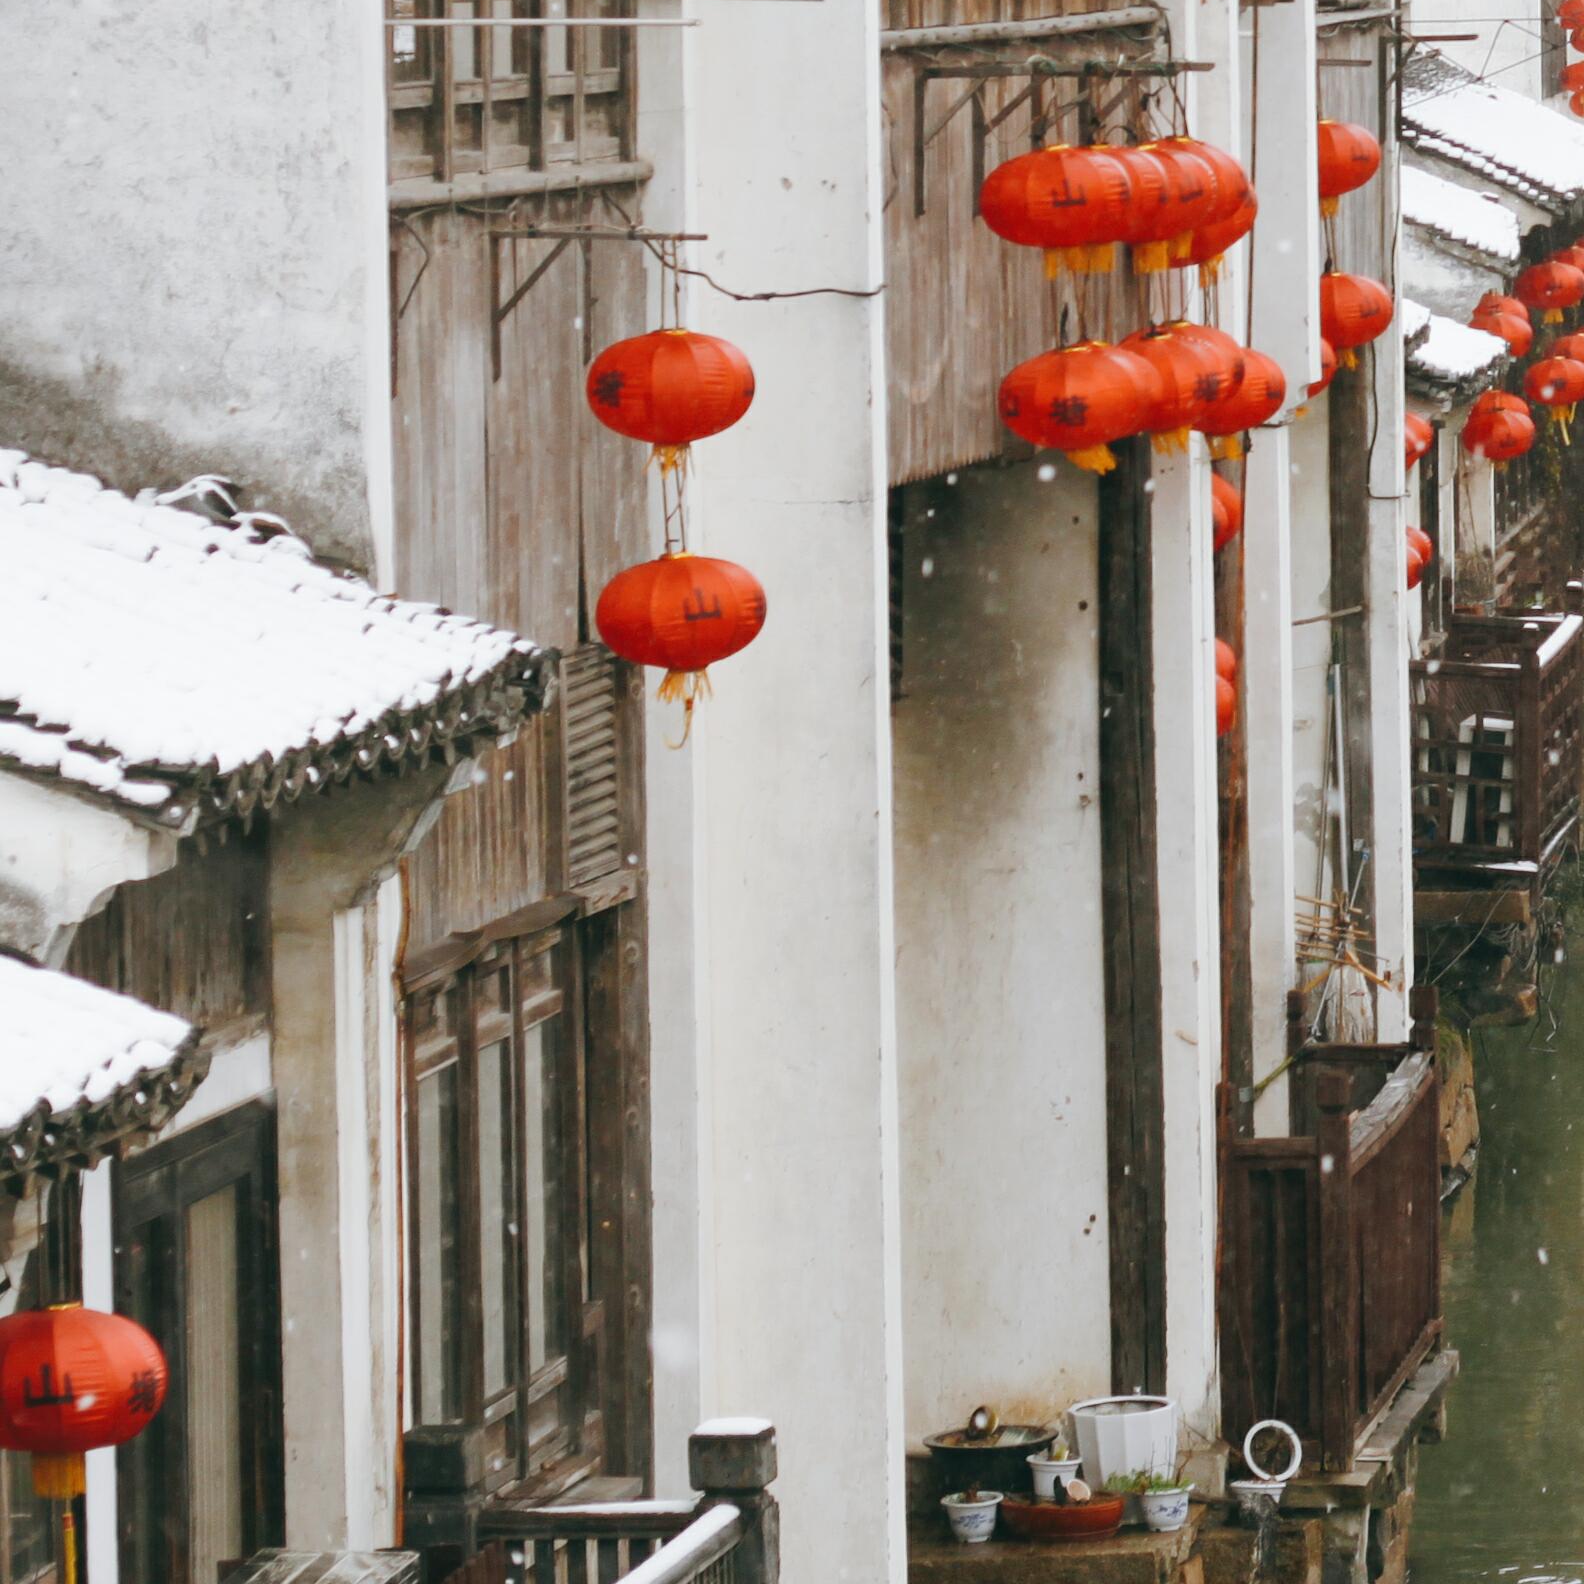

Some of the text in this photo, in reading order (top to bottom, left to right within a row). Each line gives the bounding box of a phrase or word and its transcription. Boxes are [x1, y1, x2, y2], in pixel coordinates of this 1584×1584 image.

[1052, 177, 1087, 208] 山
[683, 588, 722, 622] 山
[24, 1364, 74, 1408] 山
